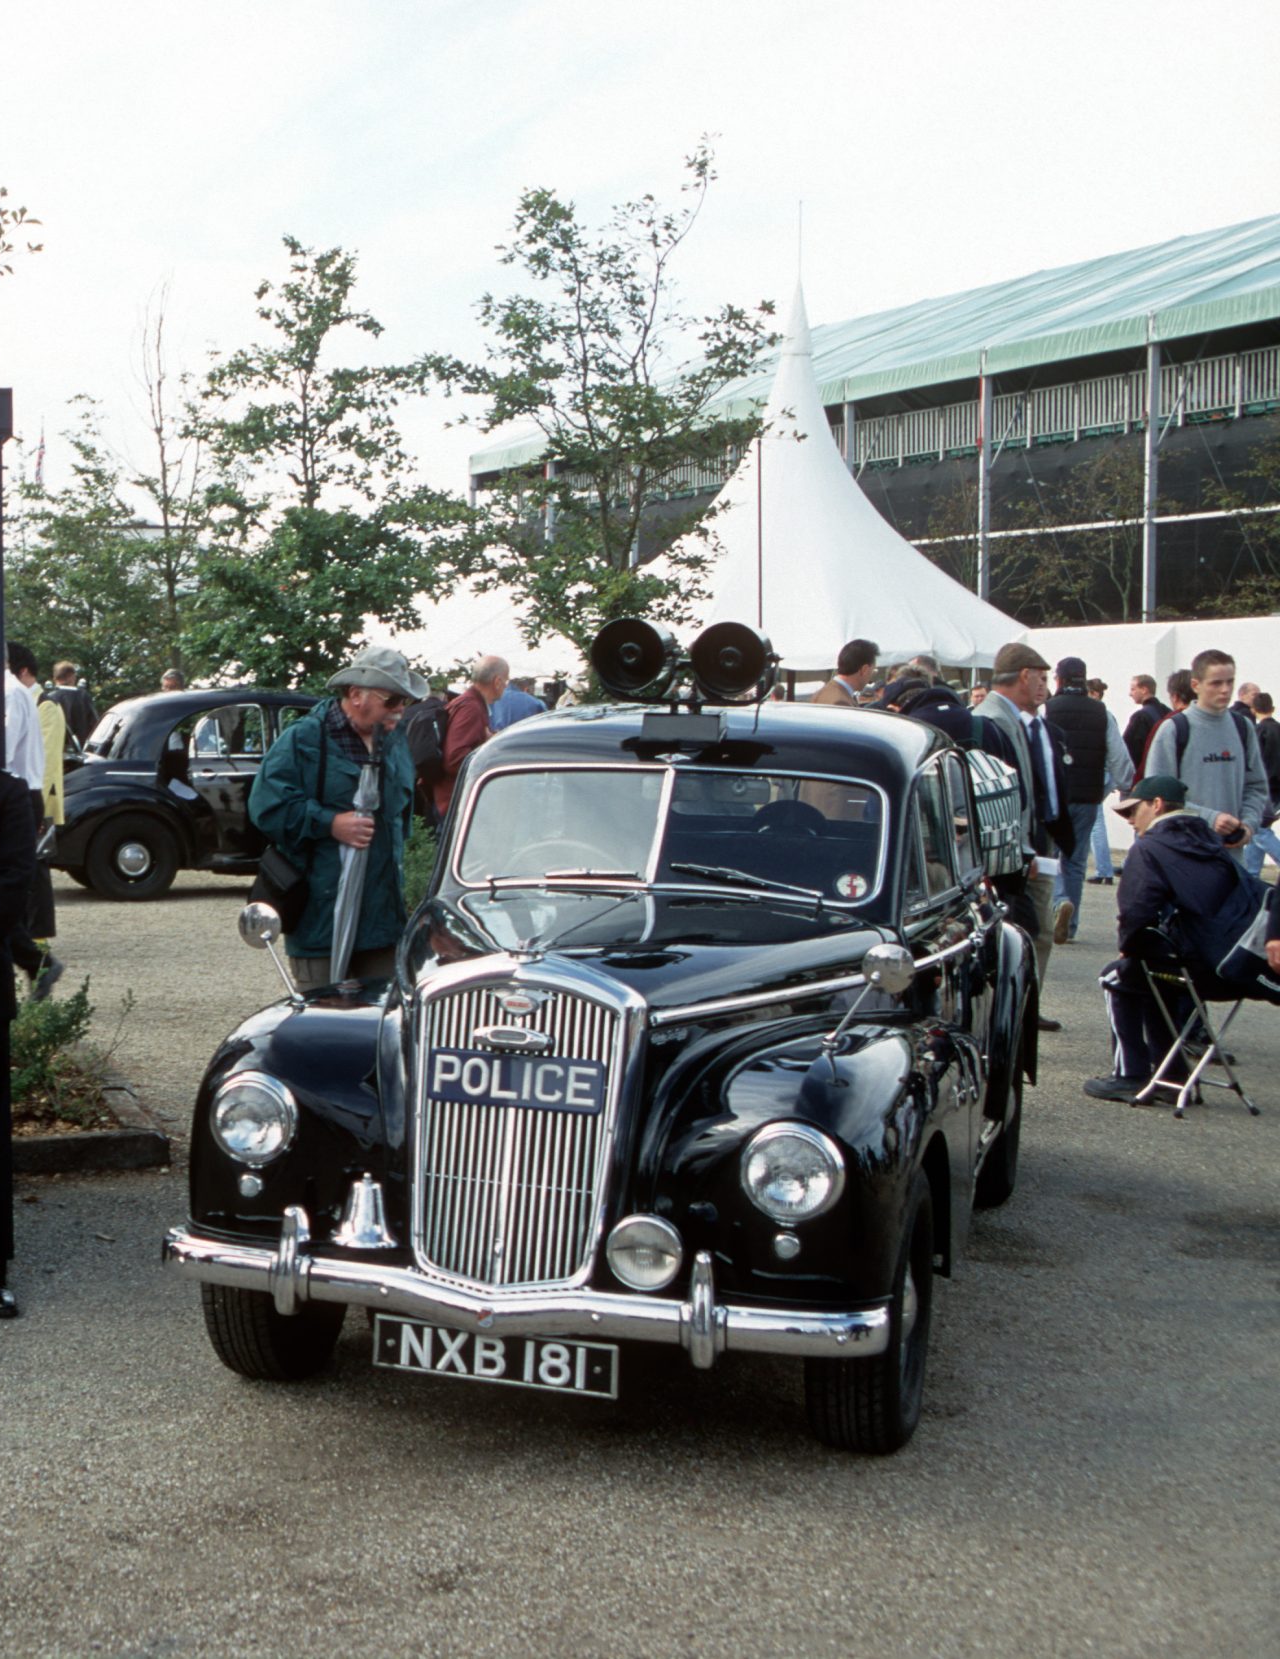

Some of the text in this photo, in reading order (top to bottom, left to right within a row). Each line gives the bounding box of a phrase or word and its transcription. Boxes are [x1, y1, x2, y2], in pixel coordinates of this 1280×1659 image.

[433, 1054, 598, 1107] POLICE
[400, 1323, 586, 1390] NXB 181
